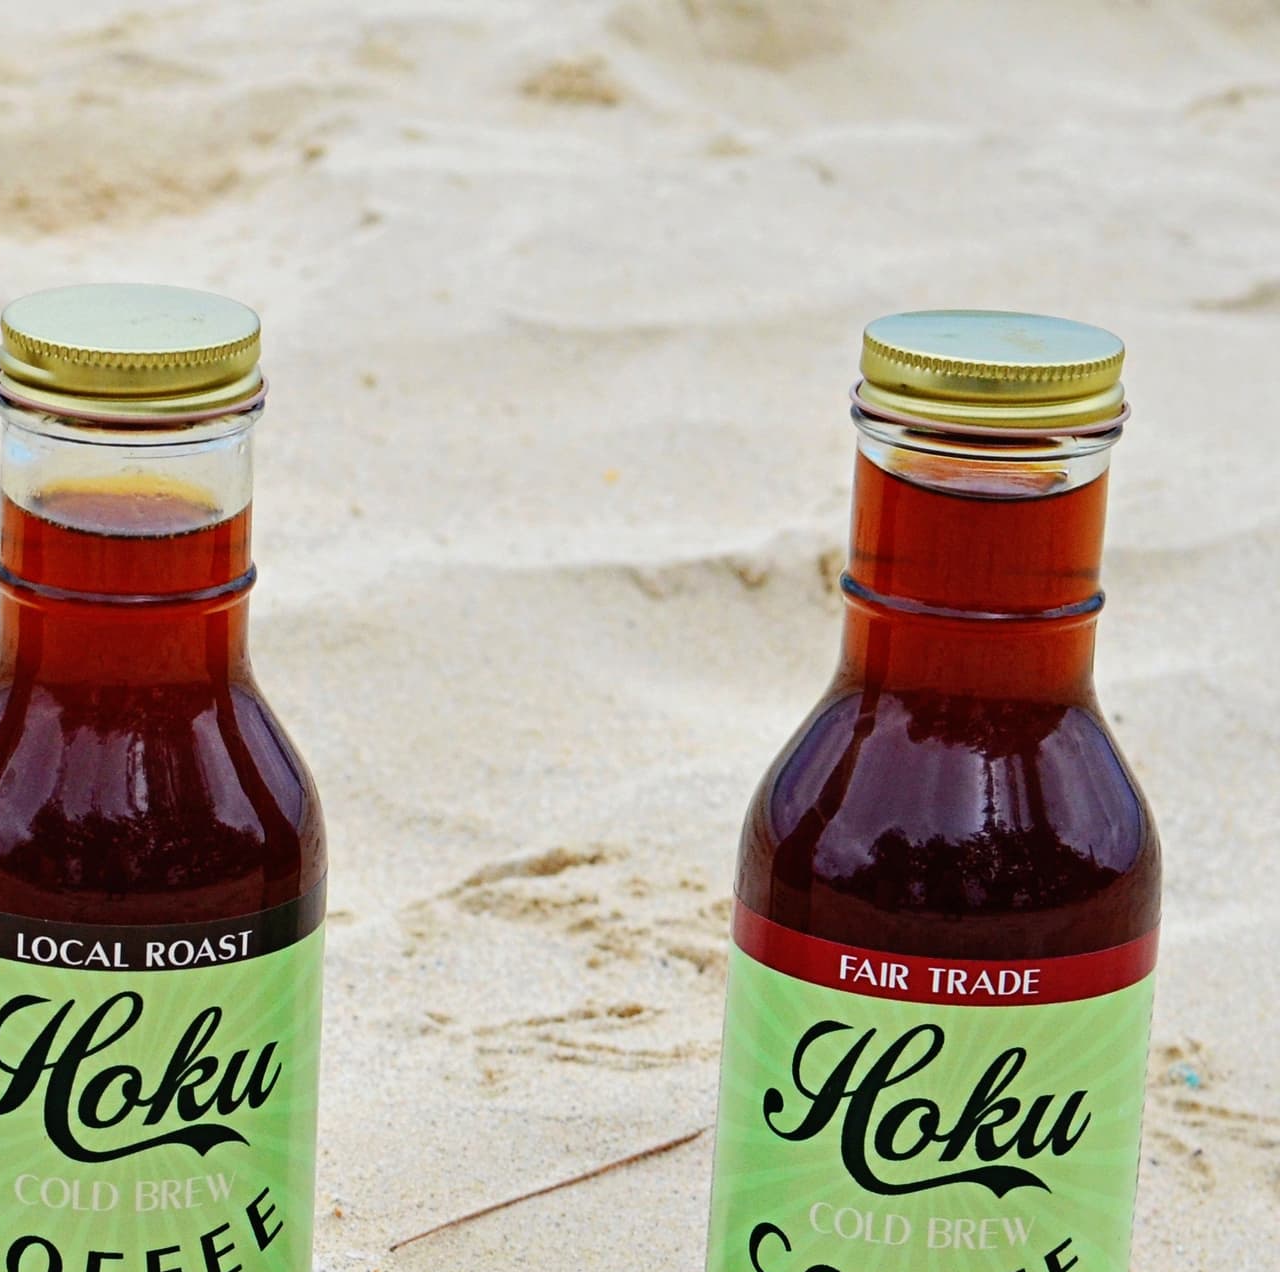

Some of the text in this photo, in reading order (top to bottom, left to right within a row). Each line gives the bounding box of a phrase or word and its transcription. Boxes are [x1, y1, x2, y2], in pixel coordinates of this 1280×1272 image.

[17, 930, 253, 968] LOCAL ROAST
[840, 955, 1041, 996] FAIR TRADE
[763, 1020, 1092, 1199] Hoku
[14, 1171, 237, 1212] COLD BREW
[809, 1202, 1036, 1250] COLD BREW
